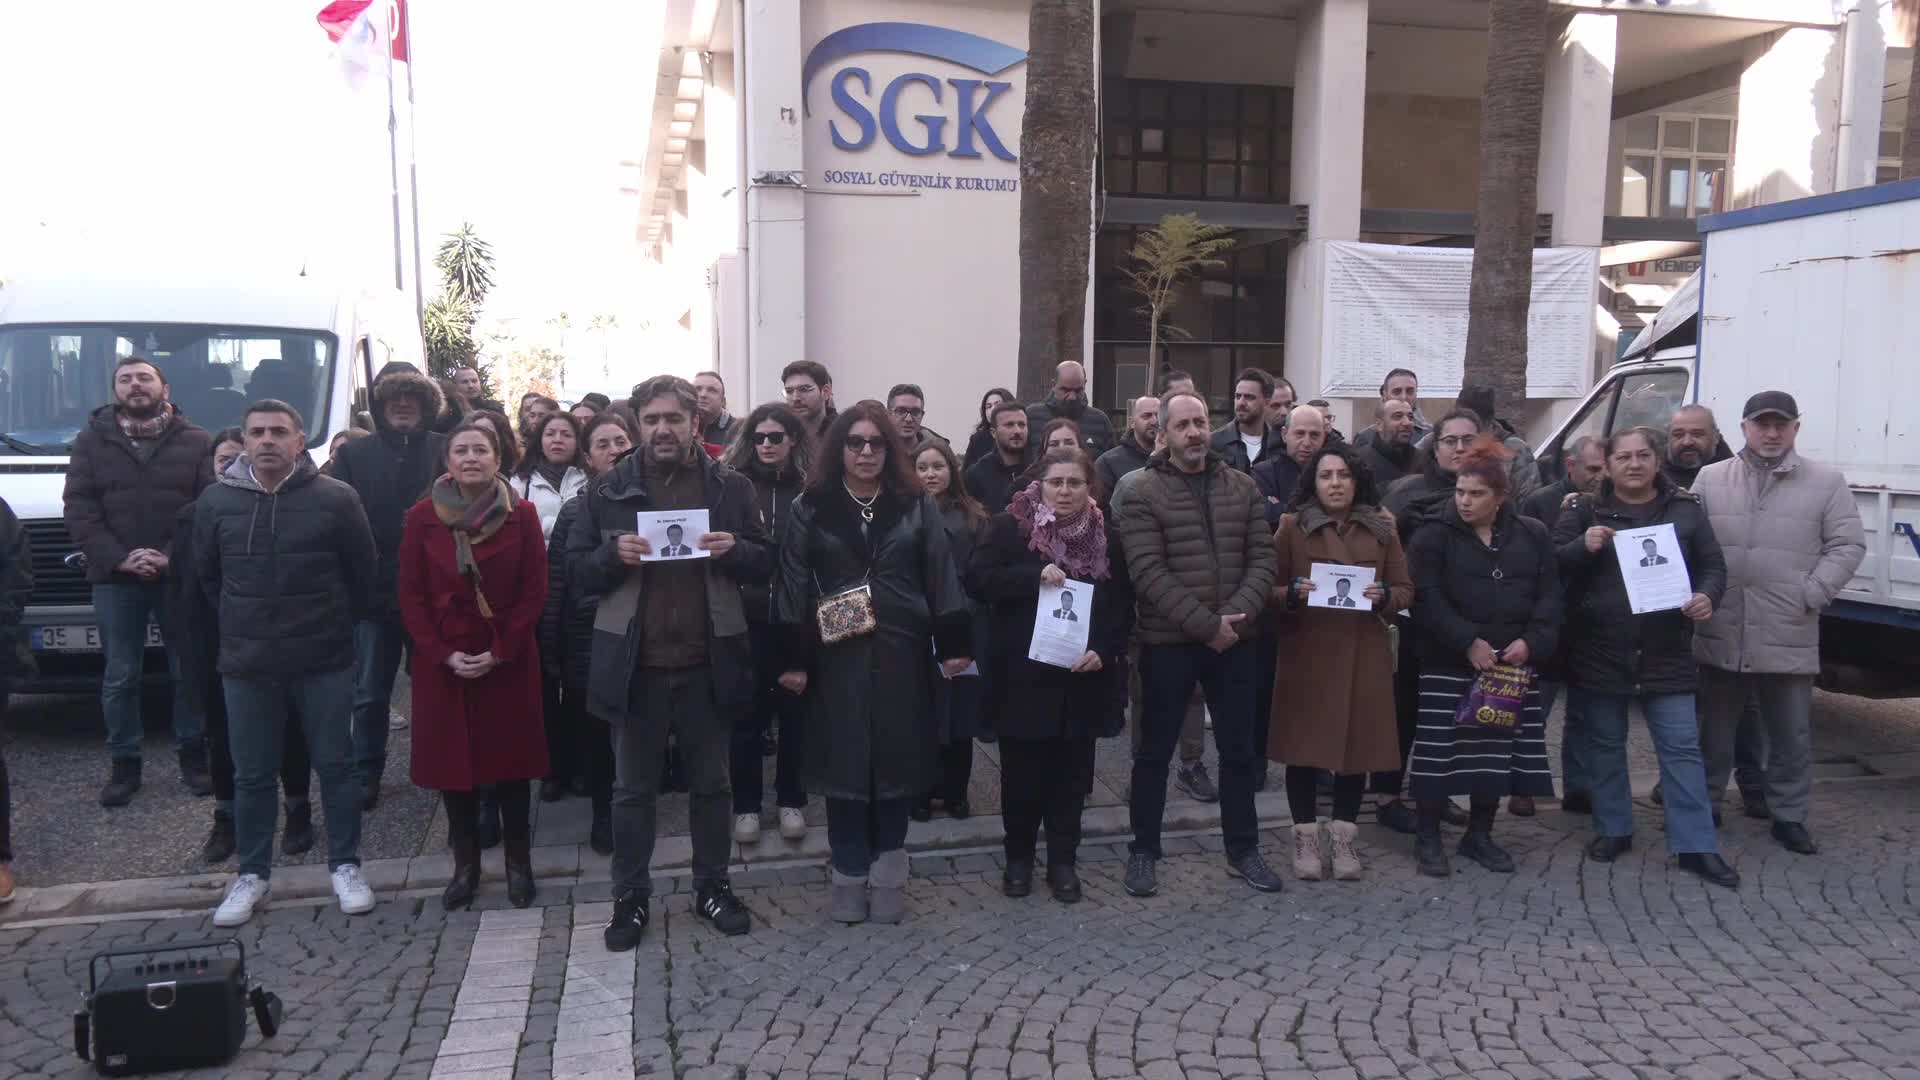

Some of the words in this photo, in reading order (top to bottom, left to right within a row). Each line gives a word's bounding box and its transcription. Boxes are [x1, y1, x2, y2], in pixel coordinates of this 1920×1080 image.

[828, 66, 1018, 162] SGK
[824, 170, 876, 185] SOSYAL
[878, 171, 952, 189] GÜVENLİK
[955, 177, 1017, 192] KURUMU
[43, 627, 66, 646] 35
